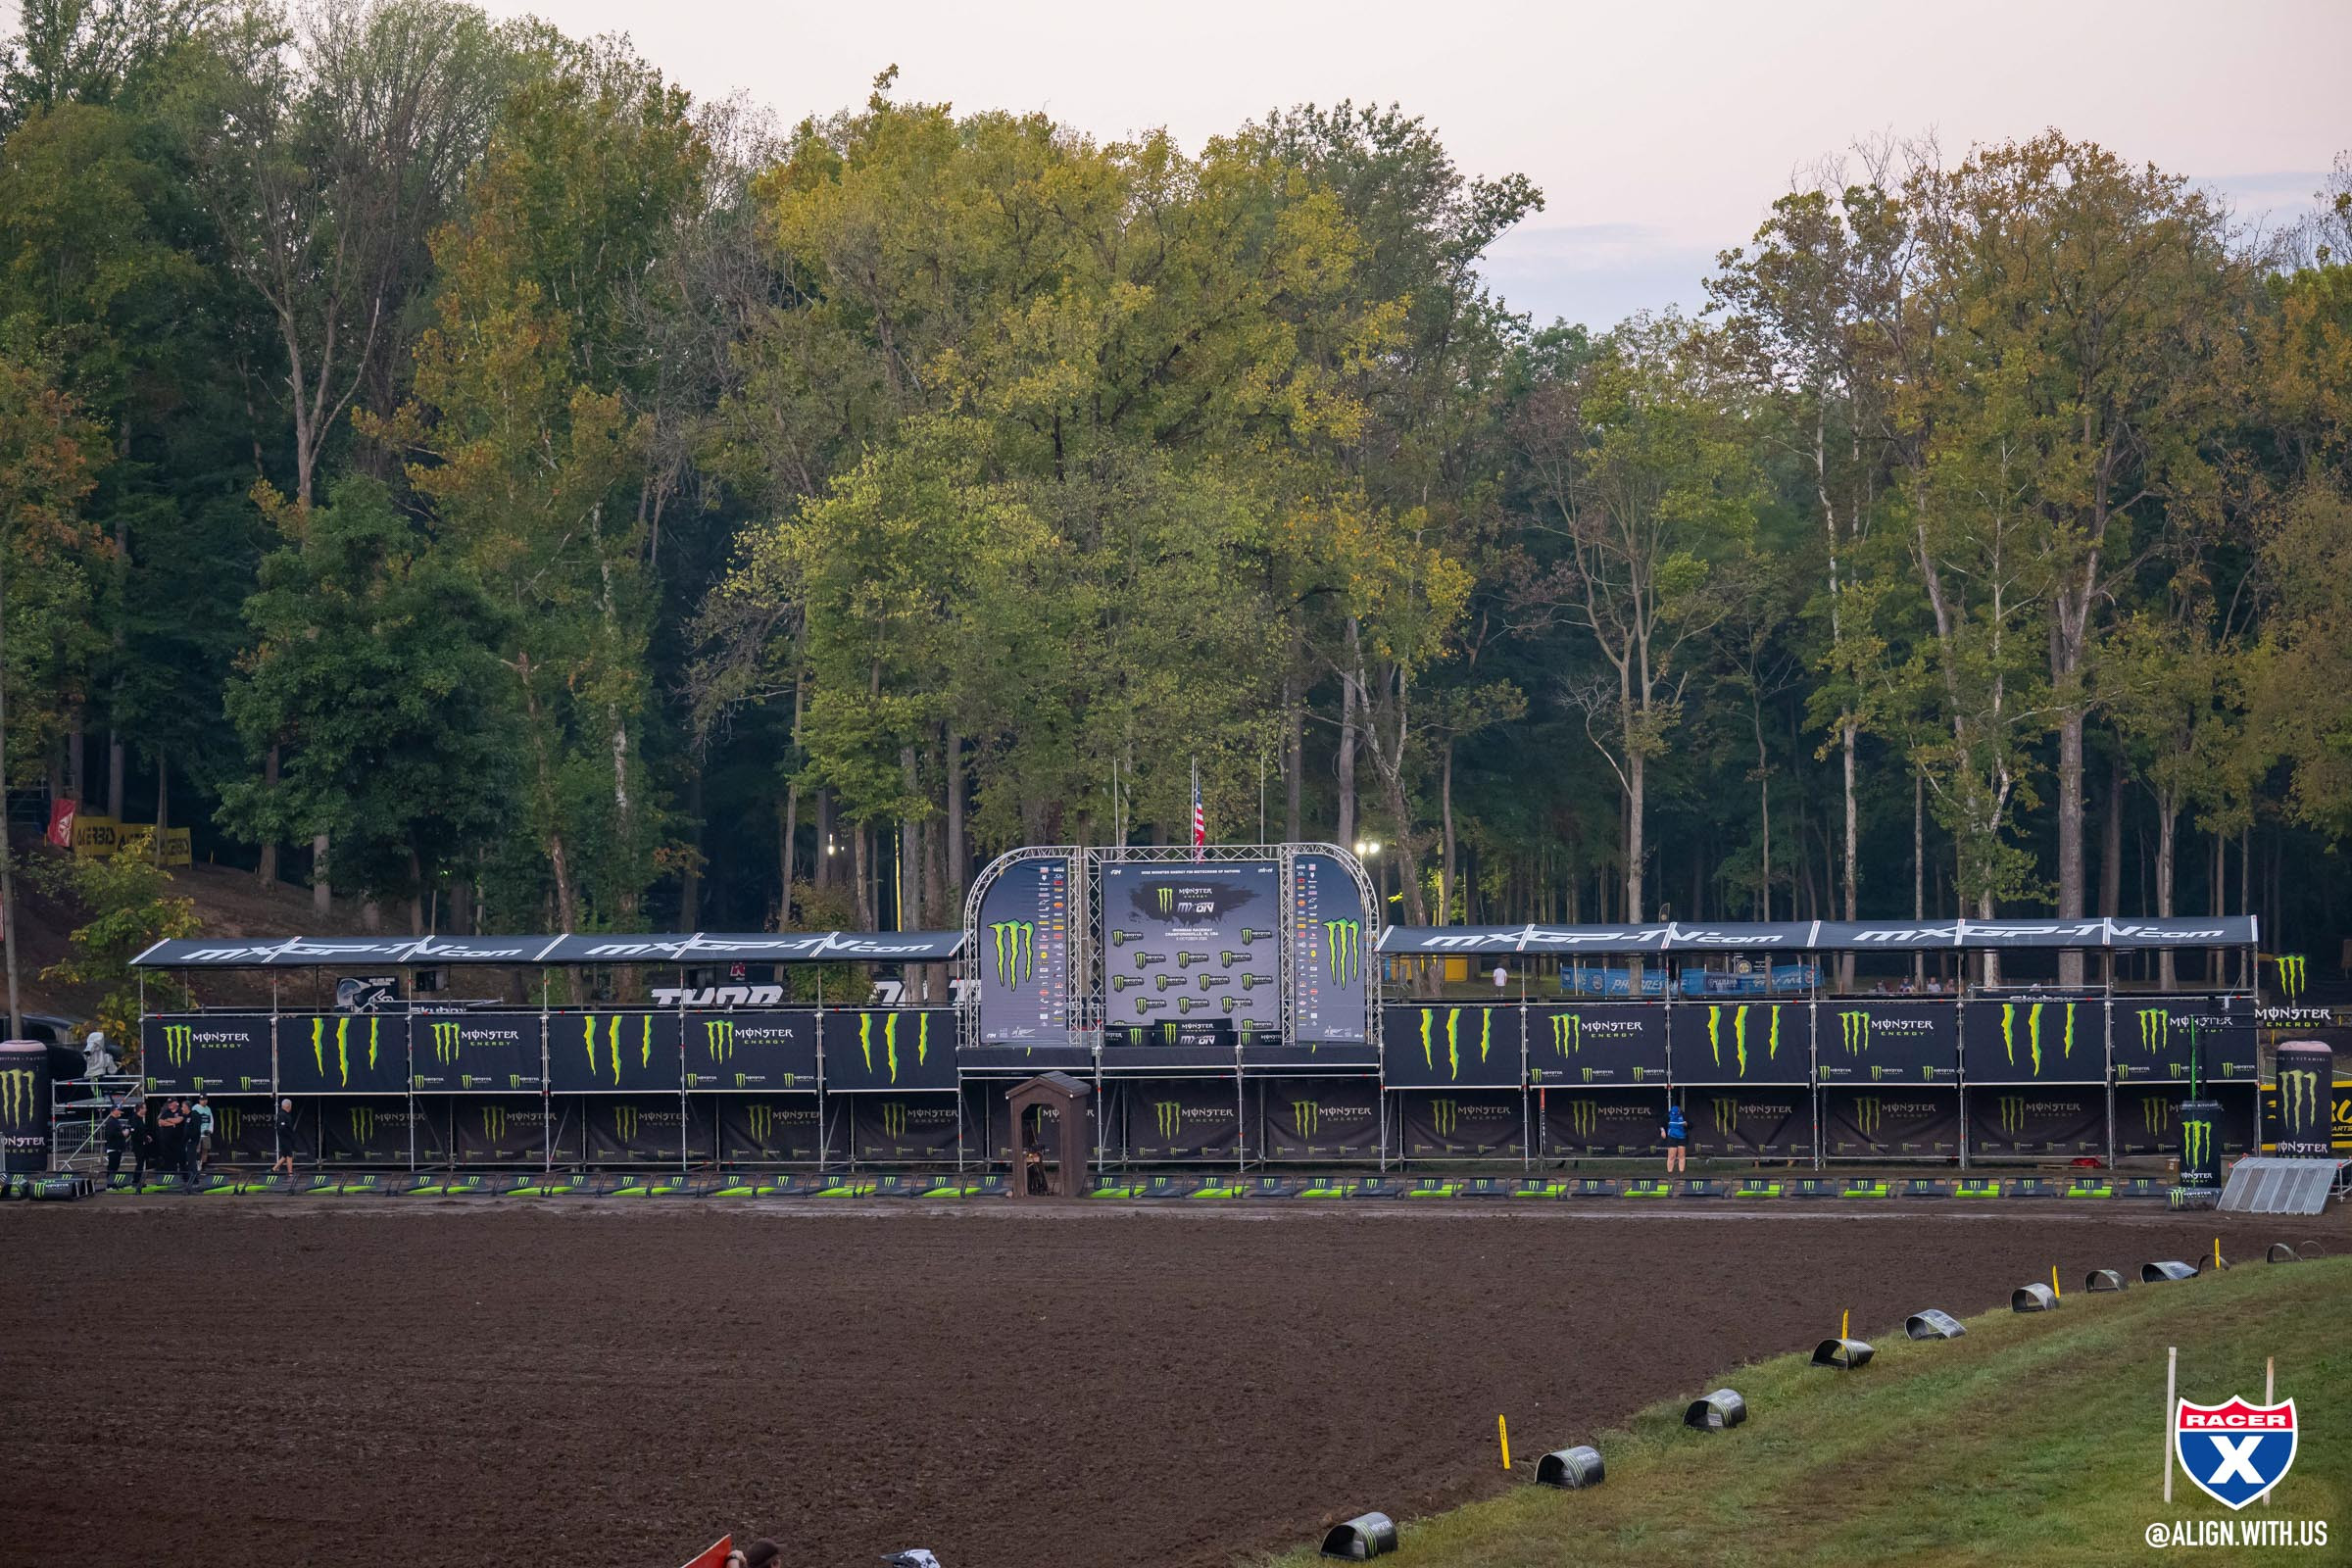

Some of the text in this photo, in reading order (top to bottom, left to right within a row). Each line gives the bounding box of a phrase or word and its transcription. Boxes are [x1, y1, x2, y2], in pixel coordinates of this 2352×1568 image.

[2255, 1005, 2331, 1021] MONSTER
[1582, 1020, 1643, 1032] MONSTER
[1871, 1018, 1935, 1030] MONSTER
[193, 1032, 250, 1043] MONSTER
[462, 1029, 519, 1041] MONSTER
[735, 1027, 794, 1039] MONSTER
[907, 1108, 958, 1118] MONSTER
[1181, 1107, 1234, 1118] MONSTER
[1319, 1106, 1372, 1117] MONSTER
[1457, 1104, 1511, 1116] MONSTER
[1597, 1105, 1652, 1117] MONSTER
[1739, 1103, 1792, 1115] MONSTER
[1882, 1102, 1936, 1114] MONSTER
[2026, 1101, 2082, 1113] MONSTER
[3, 1136, 46, 1147] NSTER
